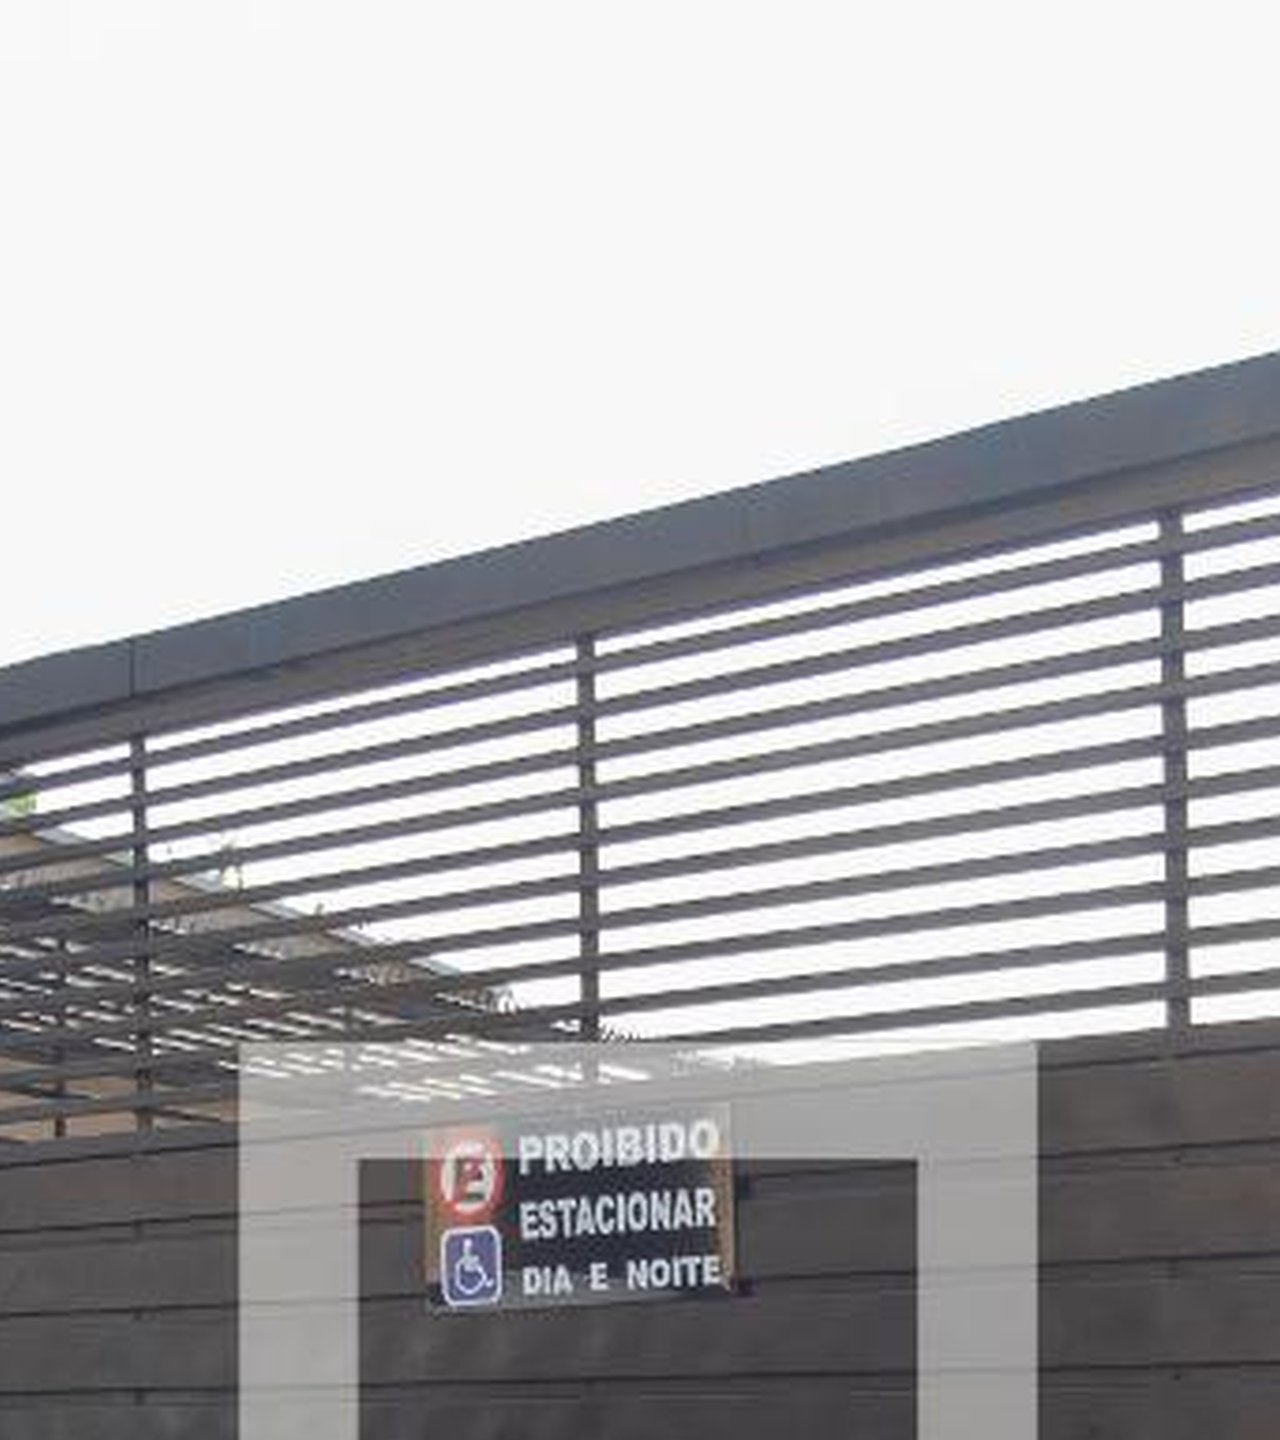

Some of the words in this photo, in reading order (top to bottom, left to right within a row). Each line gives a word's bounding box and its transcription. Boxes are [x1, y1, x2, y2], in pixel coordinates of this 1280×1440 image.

[519, 1119, 720, 1175] PROIBIDO
[521, 1187, 716, 1241] ESTACIONAR
[523, 1266, 573, 1295] DIA
[590, 1262, 609, 1290] E
[627, 1256, 721, 1289] NOITE
